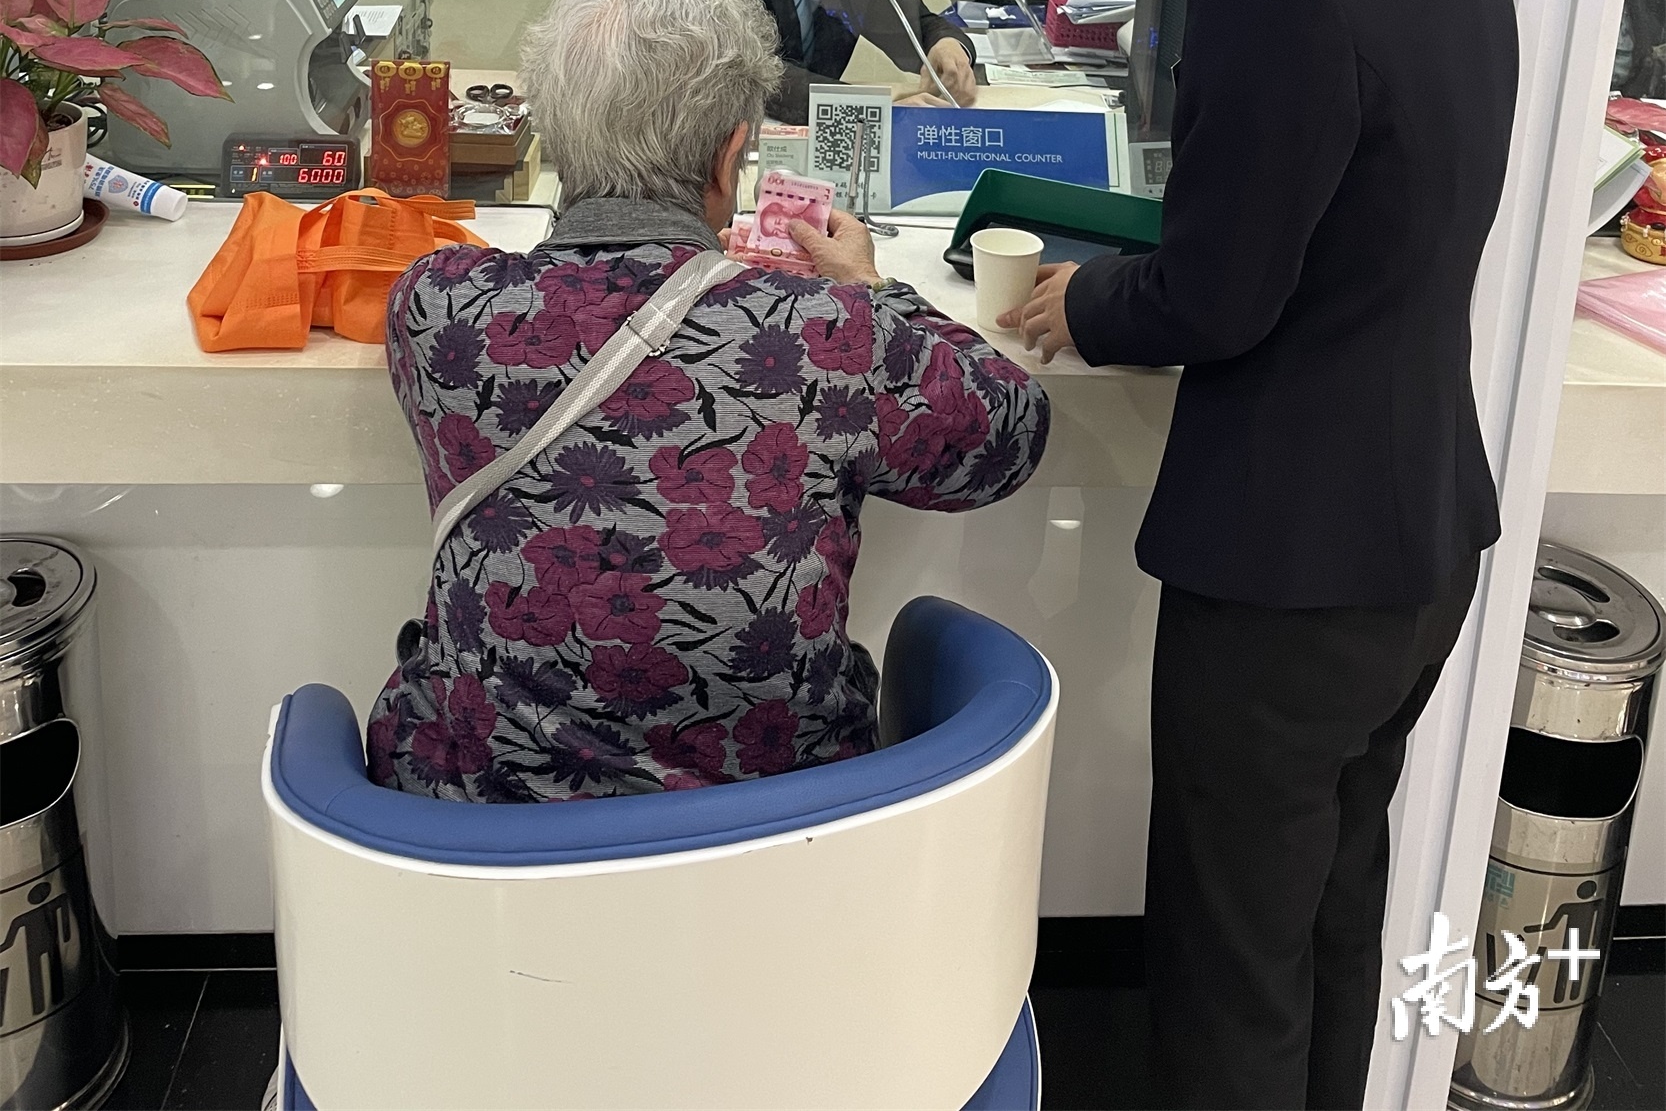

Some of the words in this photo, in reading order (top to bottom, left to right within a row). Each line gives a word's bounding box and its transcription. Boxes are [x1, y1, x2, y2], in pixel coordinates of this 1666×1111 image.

[916, 124, 1004, 148] 弹性窗口
[280, 153, 298, 165] 100
[322, 151, 345, 166] 60
[917, 150, 1012, 162] MULTI-FUNCTIONAL
[1014, 152, 1064, 164] COUNTER
[251, 167, 258, 182] 1
[298, 168, 343, 183] 6000
